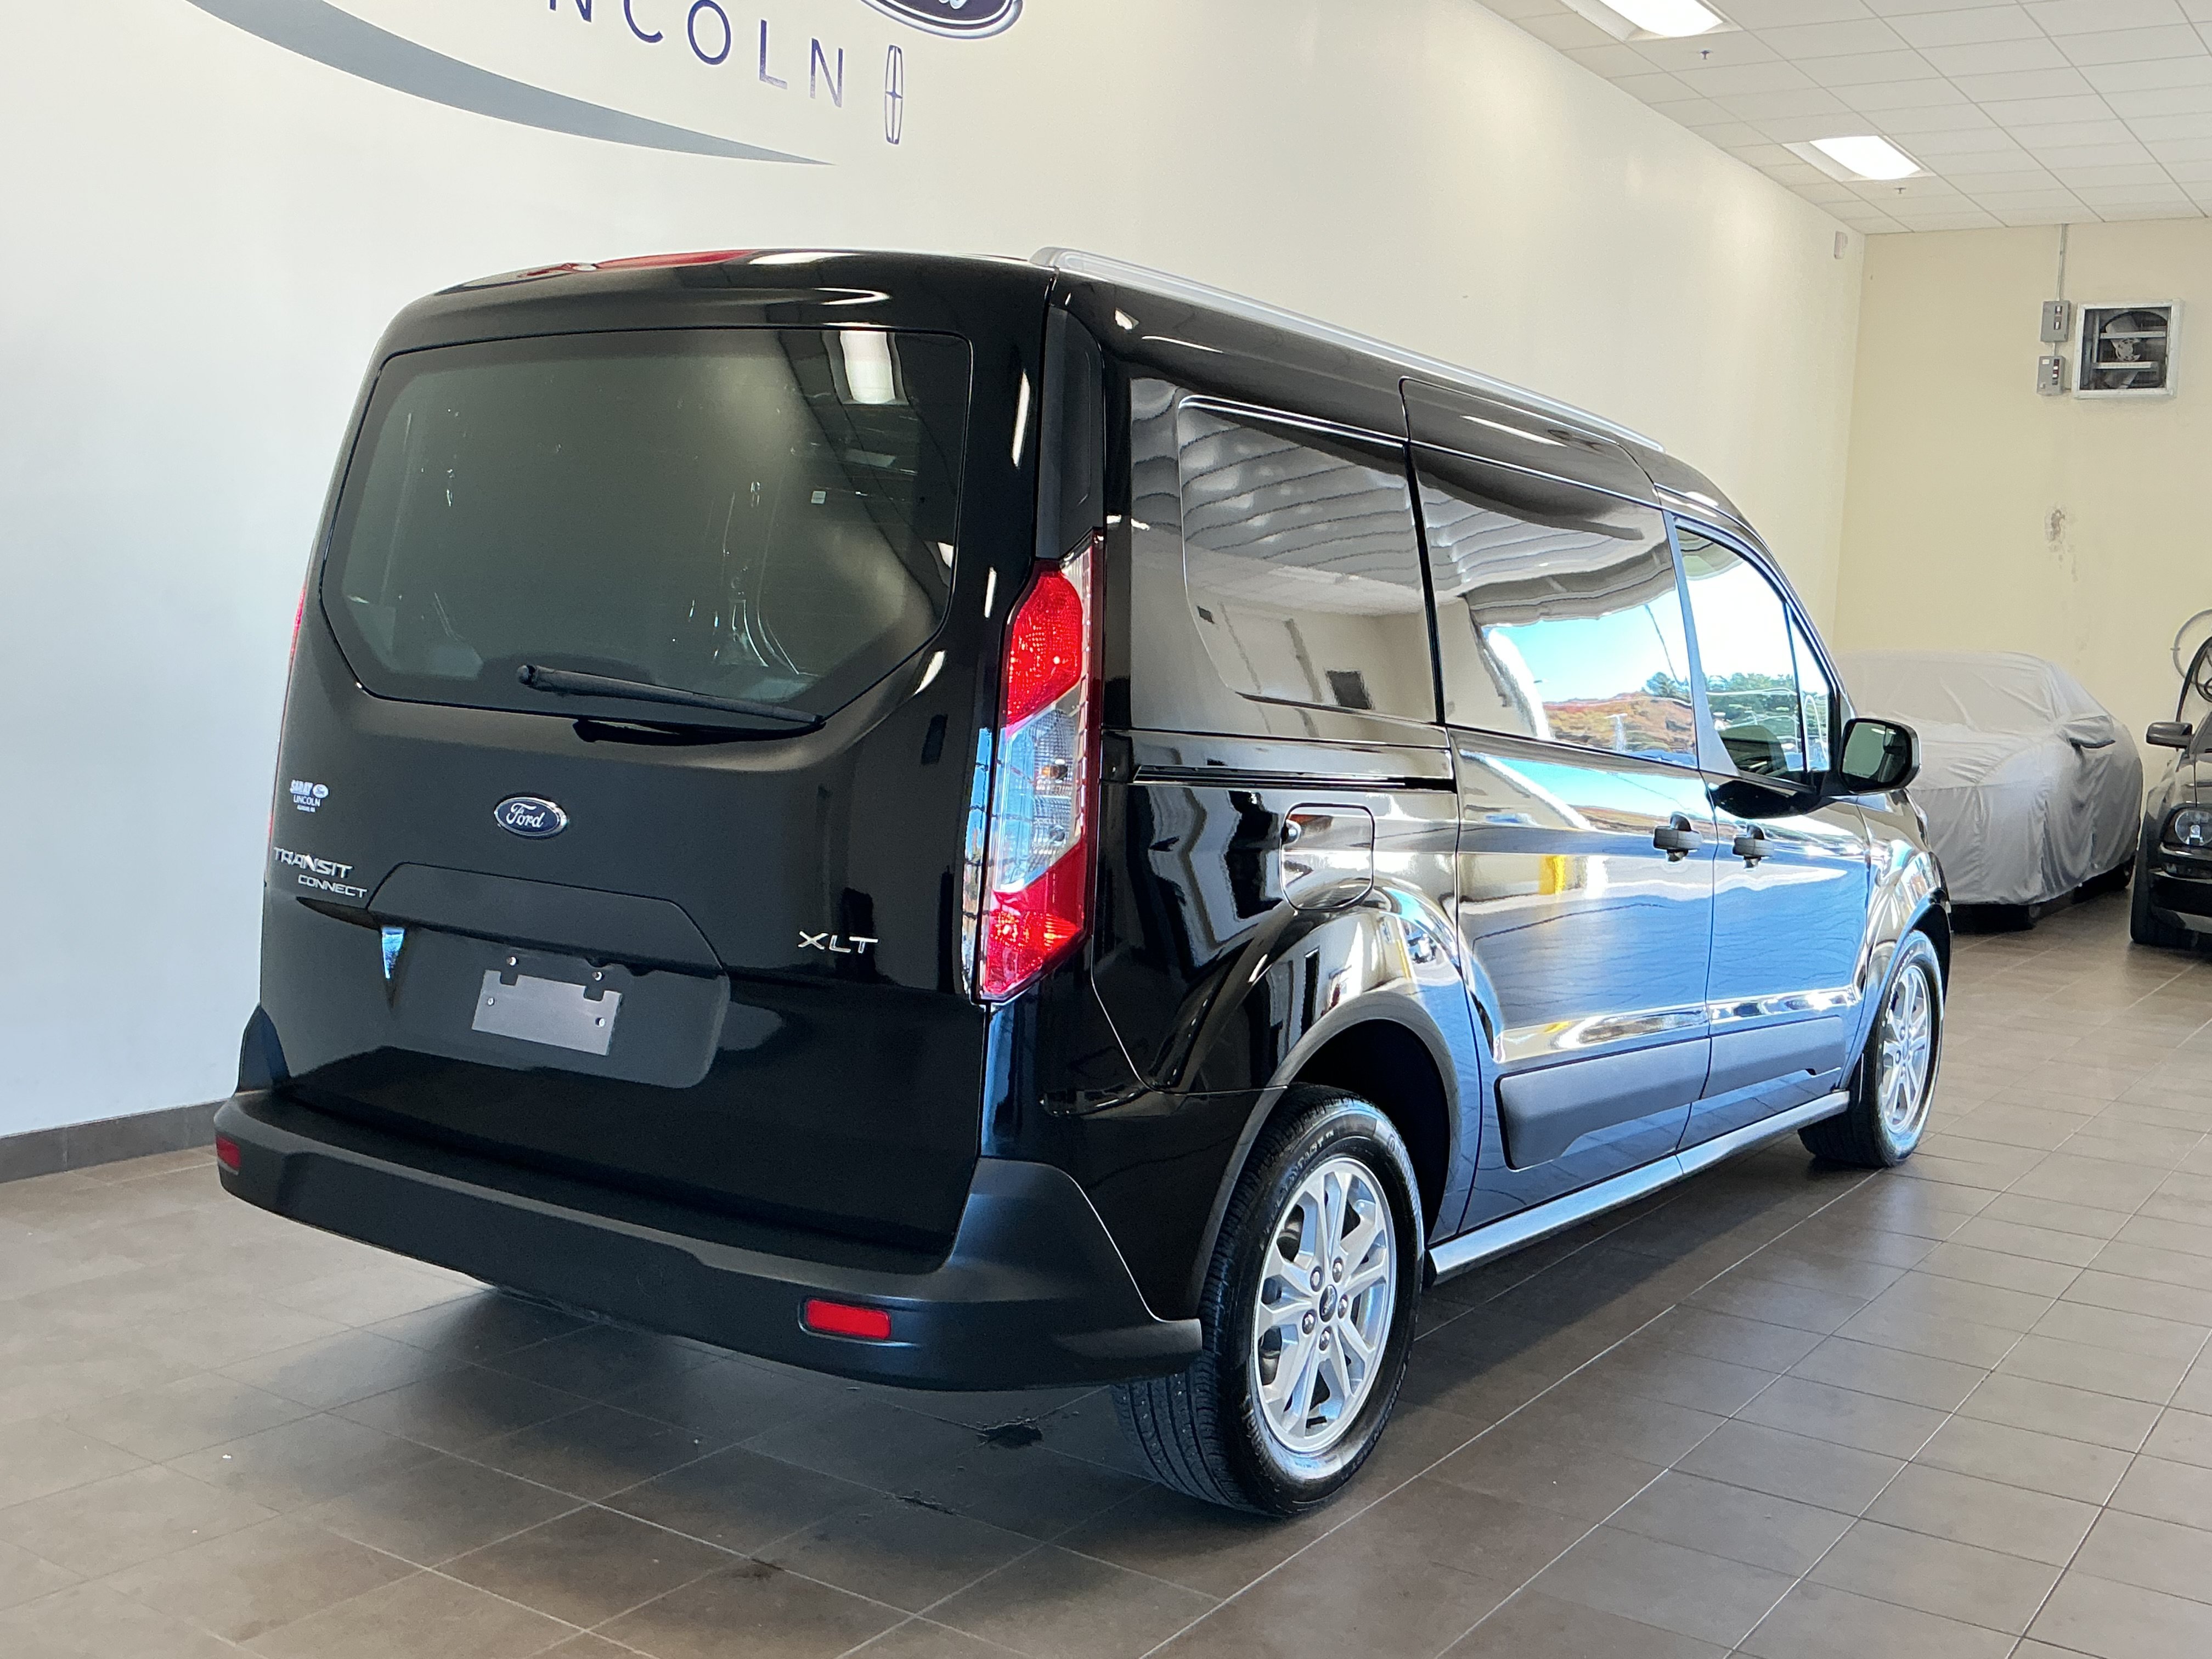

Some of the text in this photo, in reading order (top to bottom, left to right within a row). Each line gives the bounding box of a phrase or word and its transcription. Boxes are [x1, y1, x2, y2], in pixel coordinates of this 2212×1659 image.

[293, 794, 321, 807] LINCOLN
[506, 802, 545, 828] Ford
[274, 847, 353, 878] TRANSIT
[298, 874, 368, 898] CONNECT
[798, 931, 879, 953] XLT
